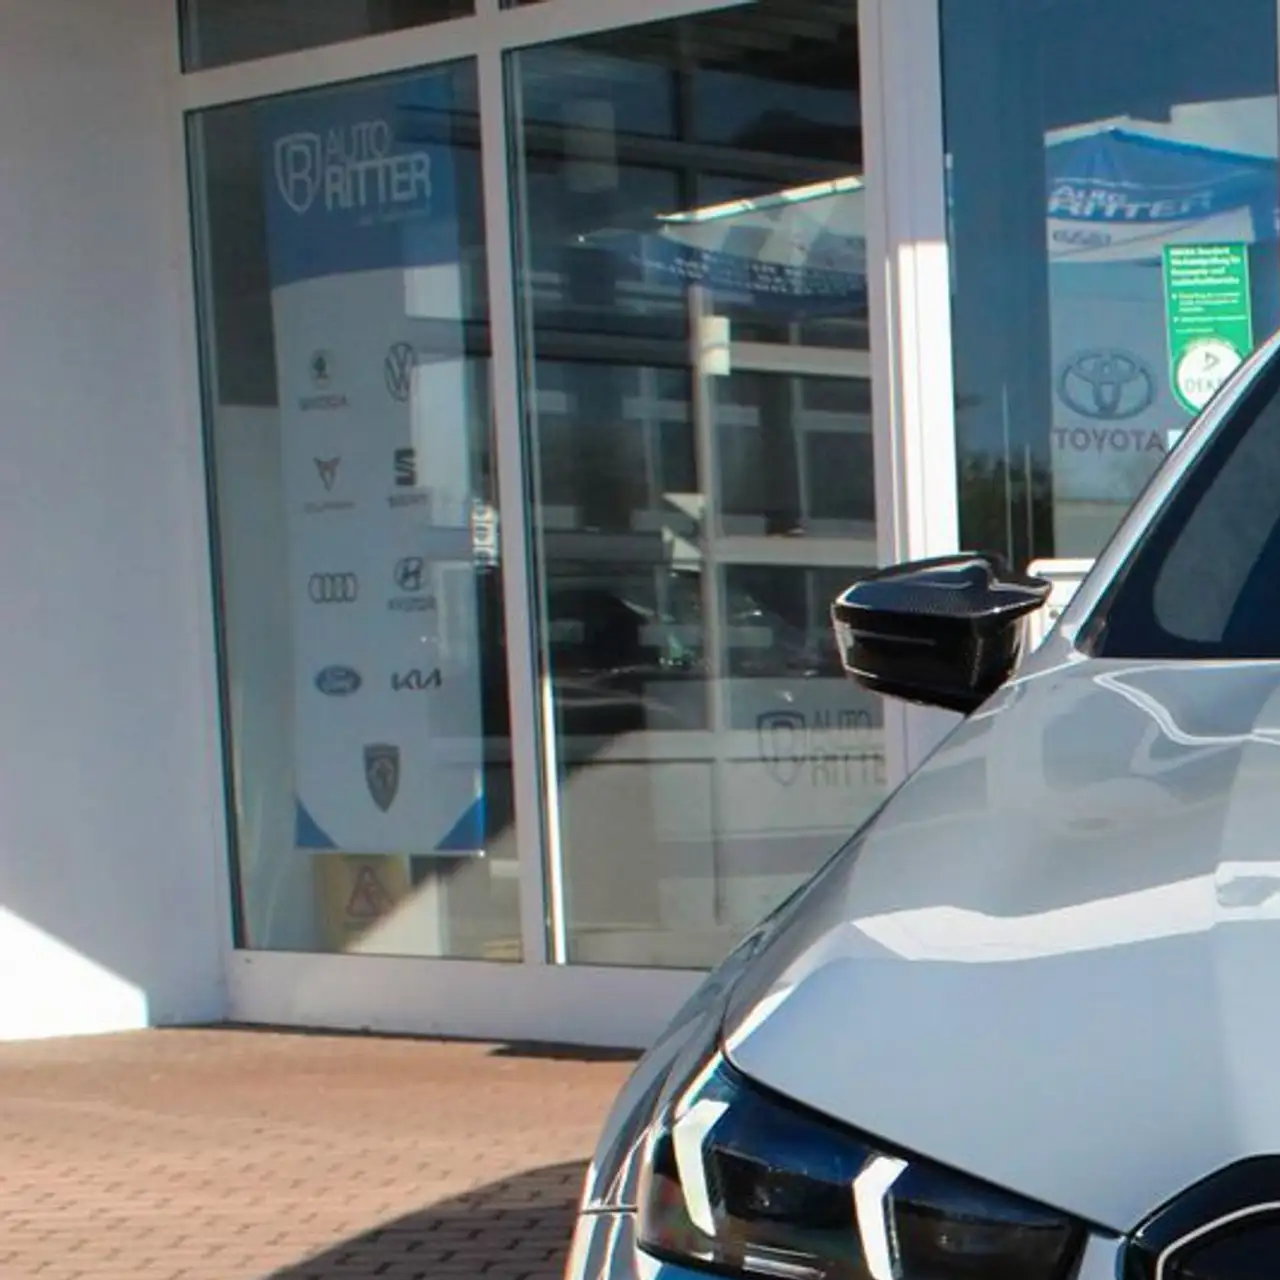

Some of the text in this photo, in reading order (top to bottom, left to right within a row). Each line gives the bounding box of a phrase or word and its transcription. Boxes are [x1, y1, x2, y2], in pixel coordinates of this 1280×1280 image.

[324, 151, 432, 212] RITTER
[1053, 427, 1167, 453] TOYOTA
[810, 744, 887, 788] RITTE
